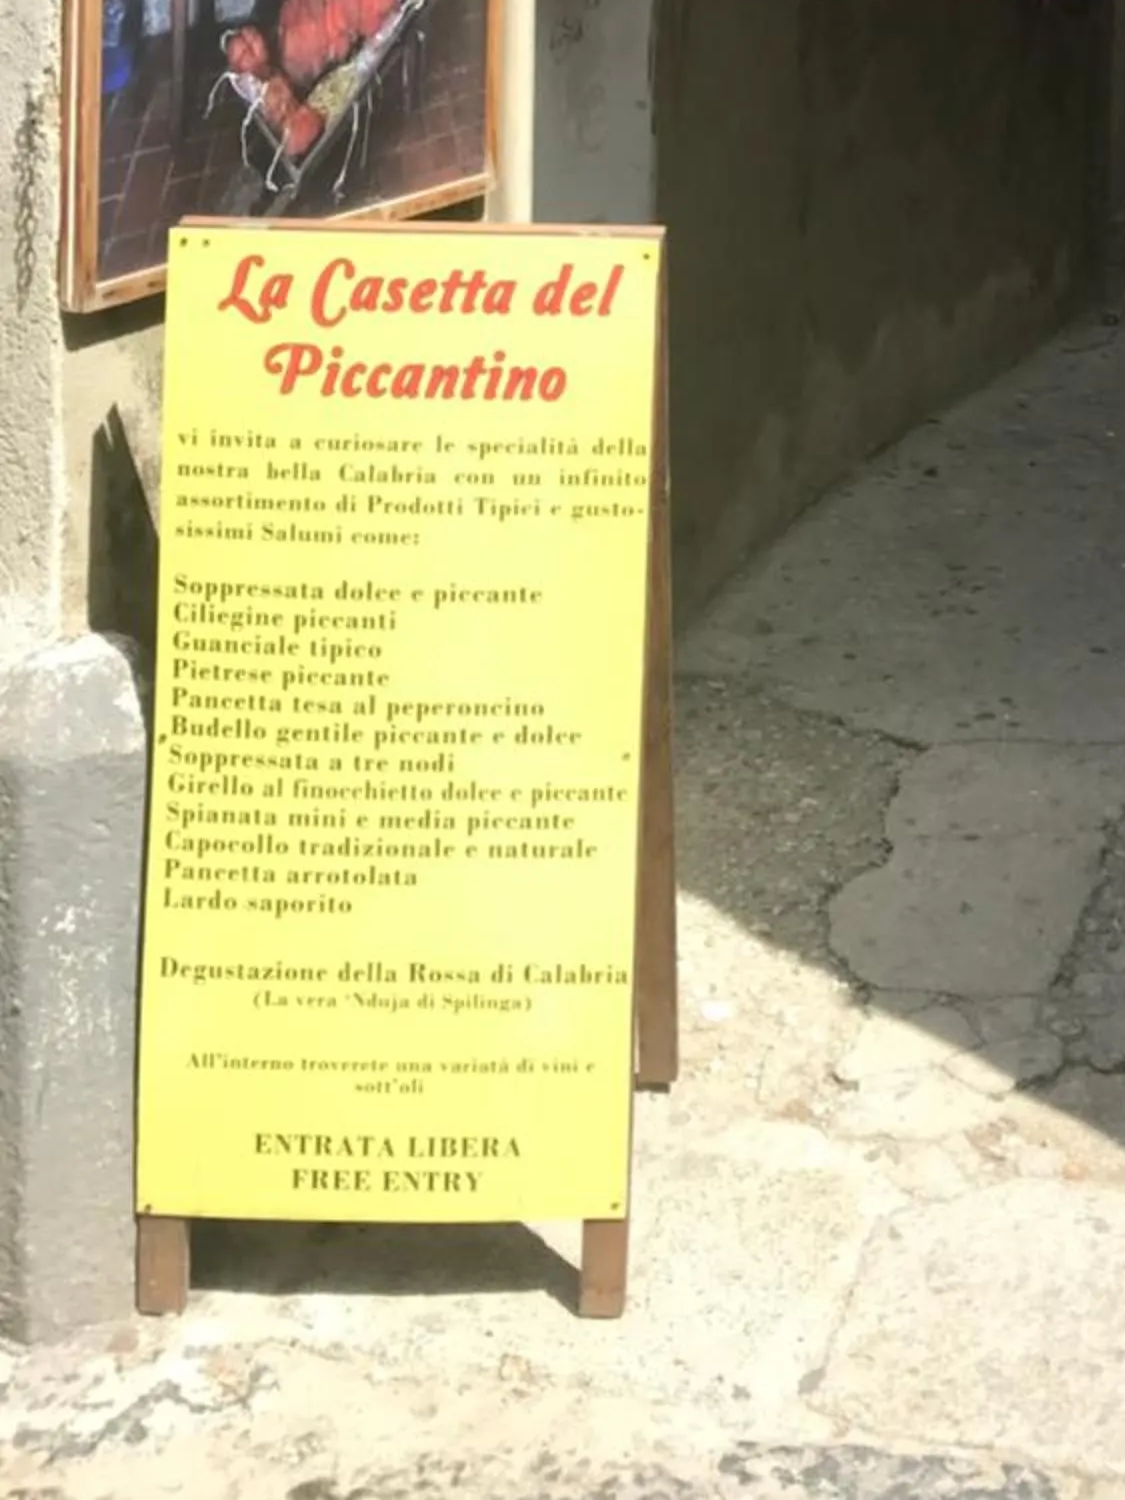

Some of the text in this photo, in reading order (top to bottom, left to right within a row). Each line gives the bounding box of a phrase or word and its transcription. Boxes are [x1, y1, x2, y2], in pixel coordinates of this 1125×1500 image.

[217, 254, 625, 328] La Casetta del
[263, 342, 567, 402] Piccantino
[178, 428, 645, 460] vi invita a curiosare le specialità della
[177, 461, 645, 486] nostra bella Calabria con un infinito
[176, 492, 326, 512] assortimento
[336, 494, 356, 513] di
[368, 495, 463, 515] Prodotti
[476, 497, 540, 522] Tipici
[550, 505, 561, 515] e
[176, 520, 419, 545] sissimi Salumi come:
[174, 574, 542, 610] Soppressata dolce e piccante
[174, 601, 396, 635] Ciliegine piccanti
[173, 629, 382, 664] Guanciale tipico
[173, 658, 389, 691] Pietrese piccante
[172, 686, 544, 723] Pancetta tesa al peperoncino
[171, 715, 581, 750] Budello gentile piccante e dolce
[169, 743, 454, 775] Soppressata a tre nodi
[168, 771, 626, 809] Girello al finocchietto dolce e piccante
[167, 802, 574, 836] Spianata mini e media piccante
[165, 828, 597, 859] Capocollo tradizionale e naturale
[165, 857, 417, 885] Pancetta arrotolata
[164, 887, 352, 919] Lardo saporito
[161, 956, 626, 985] Degustazione della Rossa di Calabria
[417, 993, 435, 1009] di
[301, 1058, 388, 1072] troverete
[396, 1062, 432, 1073] una
[516, 1058, 534, 1073] di
[585, 1063, 595, 1072] e
[256, 1133, 520, 1158] ENTRATA LIBERA
[293, 1169, 484, 1192] FREE ENTRY
